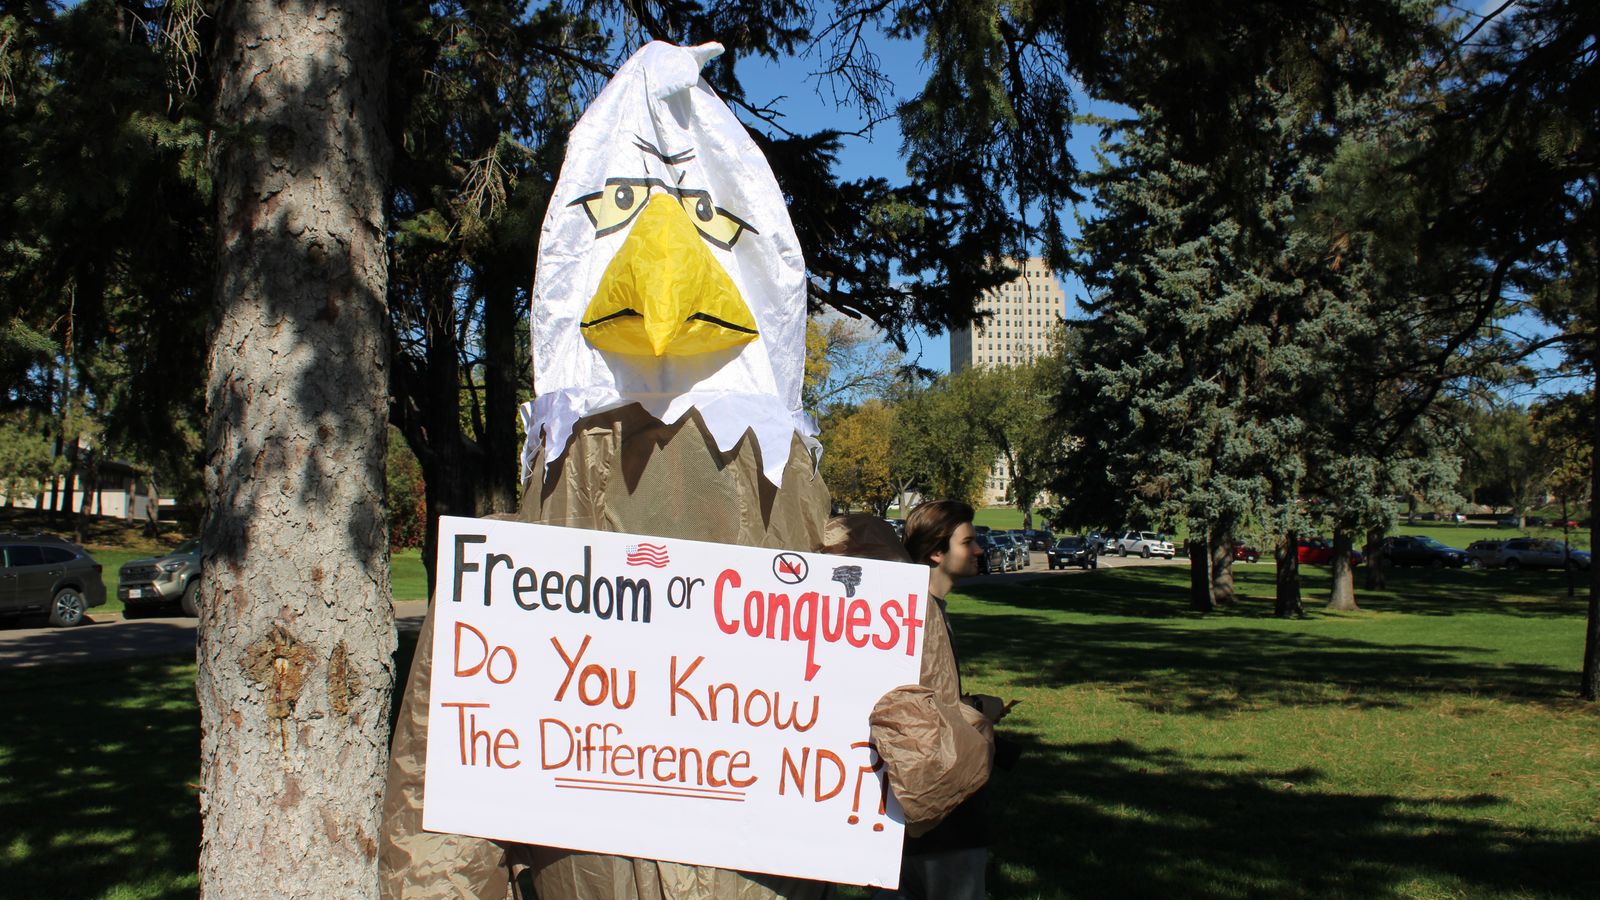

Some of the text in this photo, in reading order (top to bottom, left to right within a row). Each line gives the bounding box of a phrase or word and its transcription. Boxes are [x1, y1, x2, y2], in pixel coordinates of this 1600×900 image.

[452, 533, 923, 682] Freedom or Conquest
[454, 621, 819, 733] Do You Know
[441, 702, 521, 770] The
[539, 718, 758, 788] Difference
